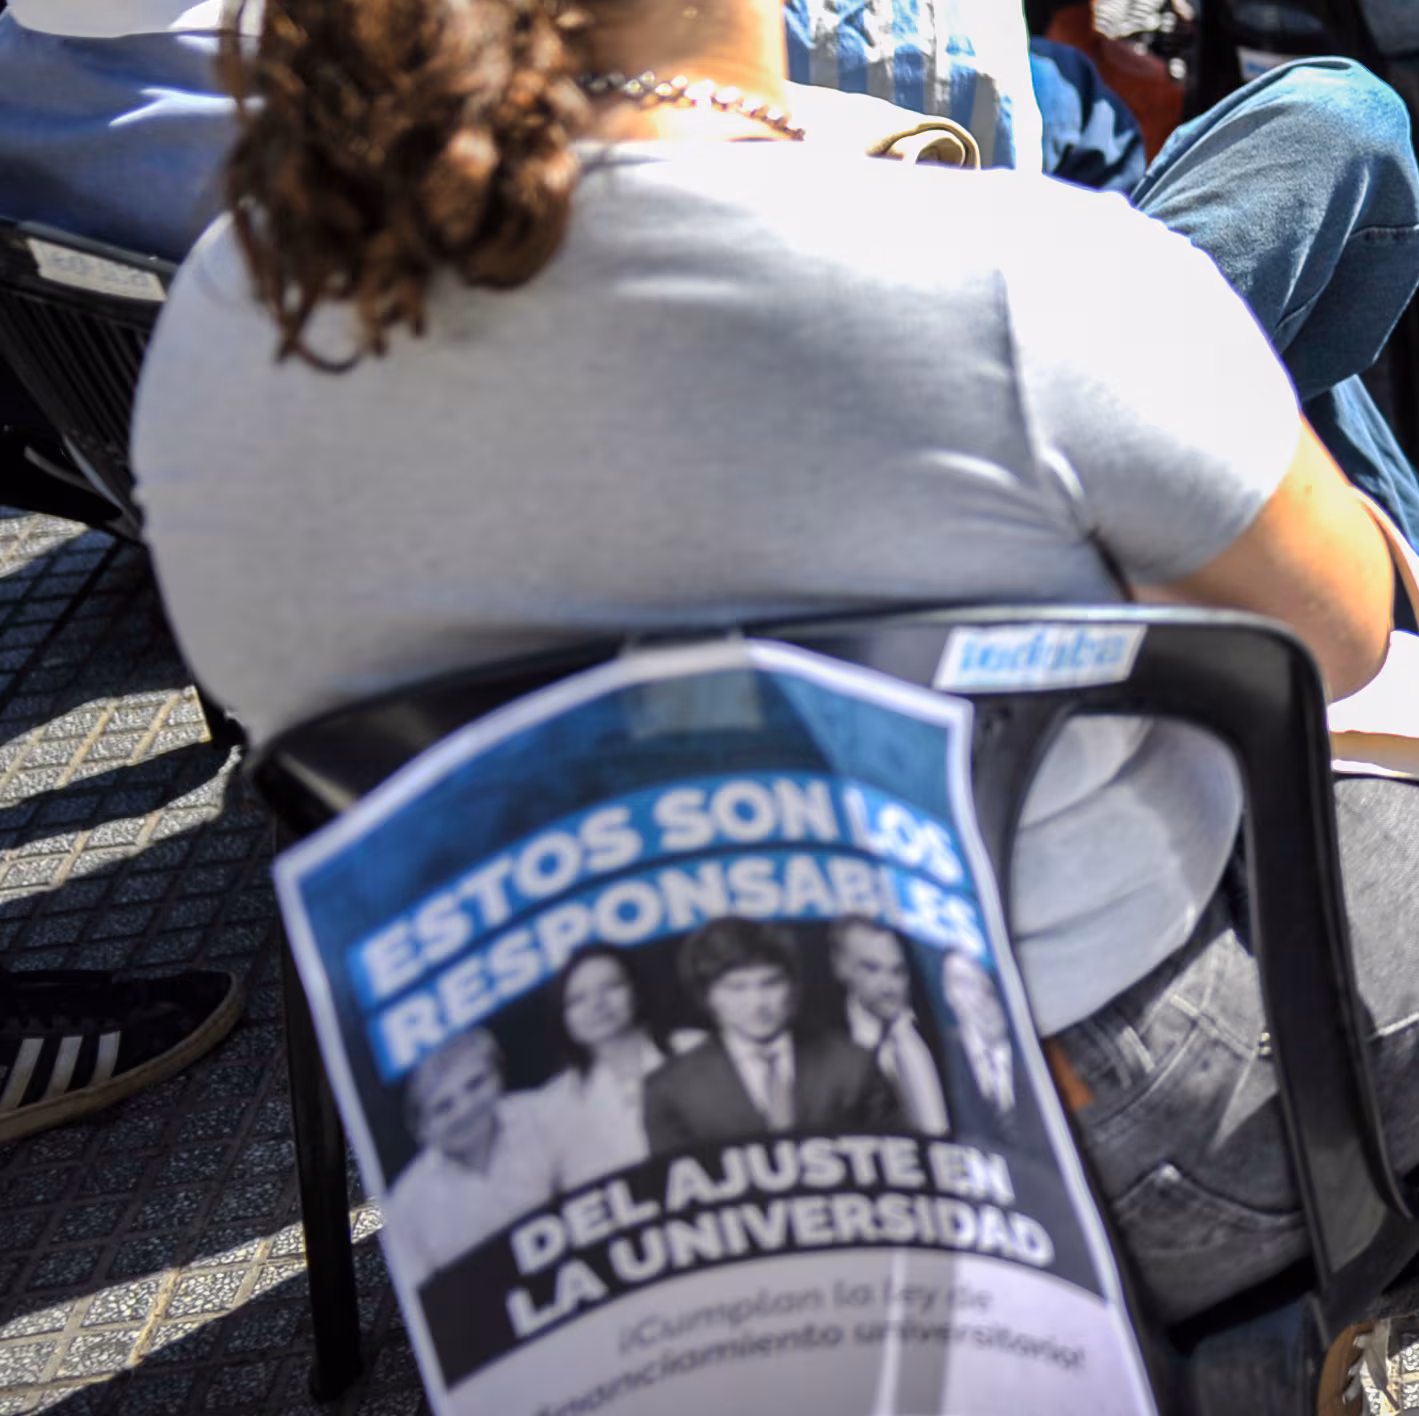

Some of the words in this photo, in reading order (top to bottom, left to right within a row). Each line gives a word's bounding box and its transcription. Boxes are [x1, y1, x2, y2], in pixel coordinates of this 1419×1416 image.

[359, 806, 644, 996] ESTOS
[651, 777, 839, 851] SON
[842, 785, 964, 886] LOS
[379, 854, 989, 1073] RESPONSABLES
[505, 1259, 609, 1339] LA
[607, 1193, 1056, 1282] UNIVERSIDAD
[510, 1178, 661, 1276] DEL
[664, 1135, 926, 1212] AJUSTE
[928, 1142, 1016, 1205] EN
[832, 1279, 876, 1308] la
[881, 1279, 940, 1312] ley
[946, 1280, 994, 1311] de
